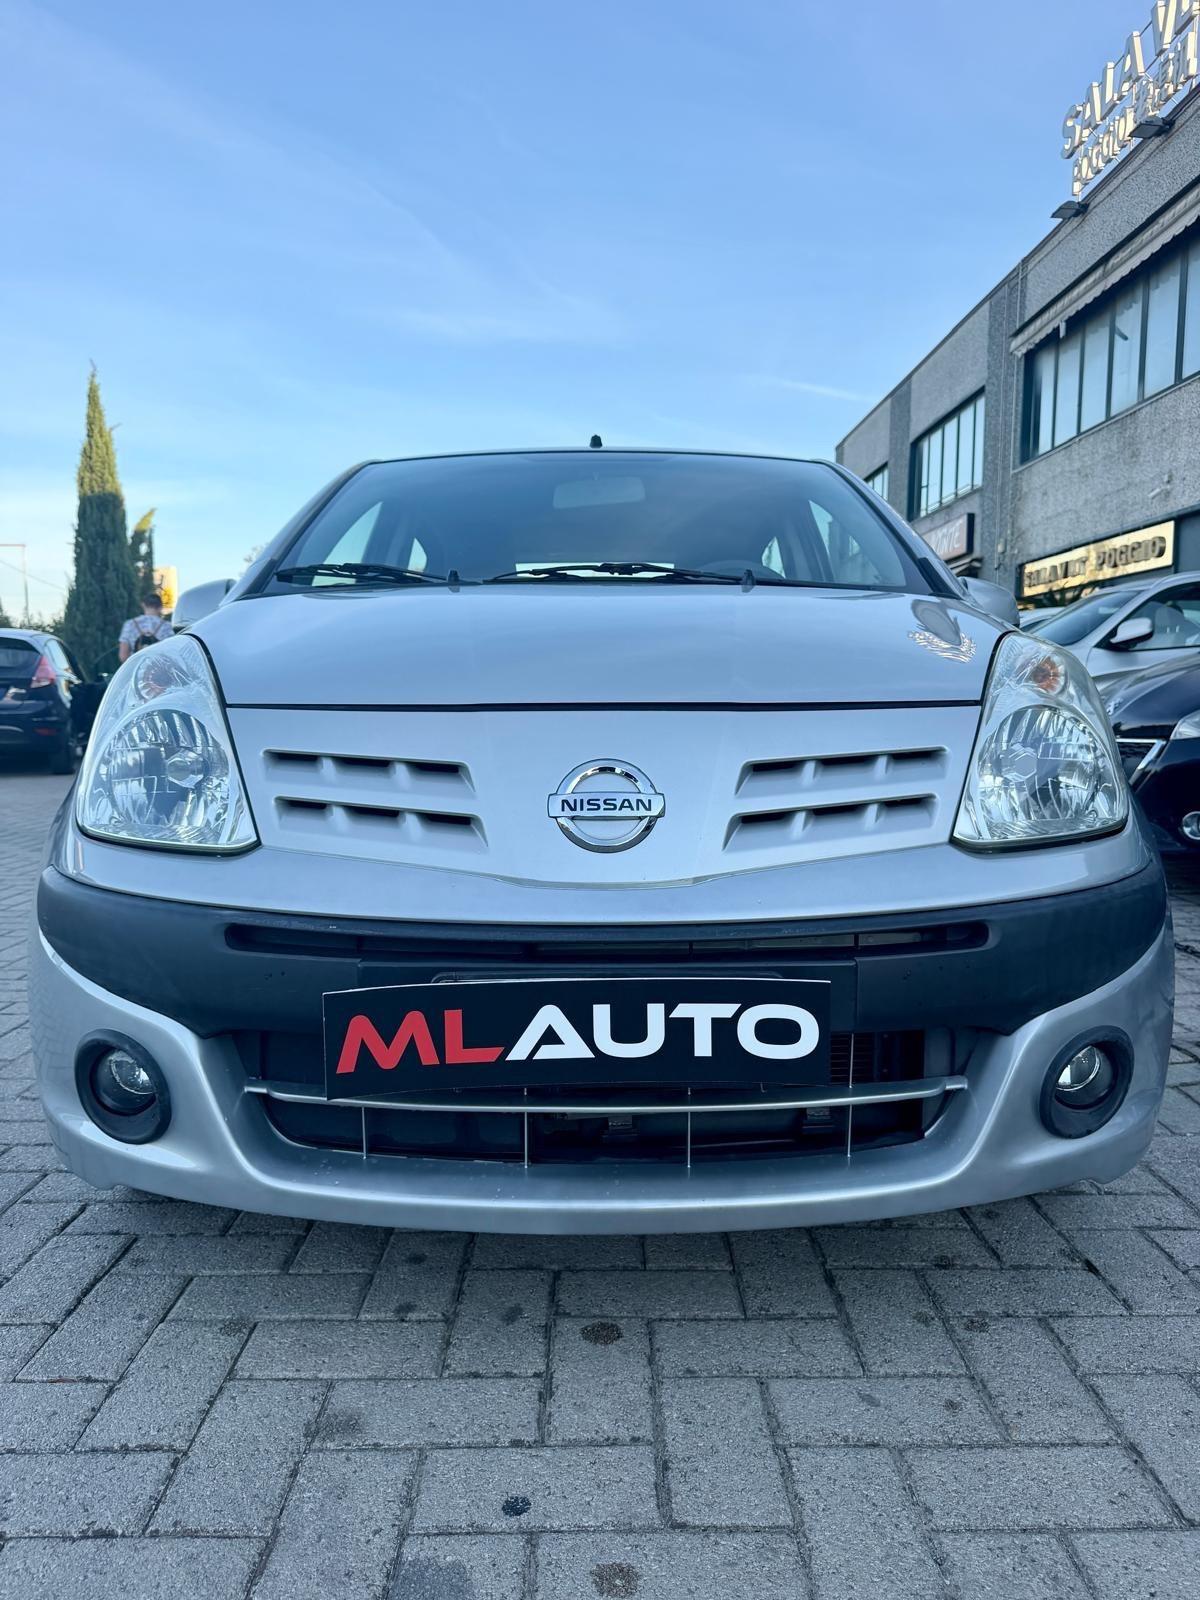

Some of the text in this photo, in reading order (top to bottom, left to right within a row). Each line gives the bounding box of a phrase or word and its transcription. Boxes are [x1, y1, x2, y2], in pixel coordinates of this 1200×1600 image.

[1061, 31, 1145, 159] SALA
[1095, 536, 1167, 570] POGGIO
[560, 798, 652, 812] NISSAN
